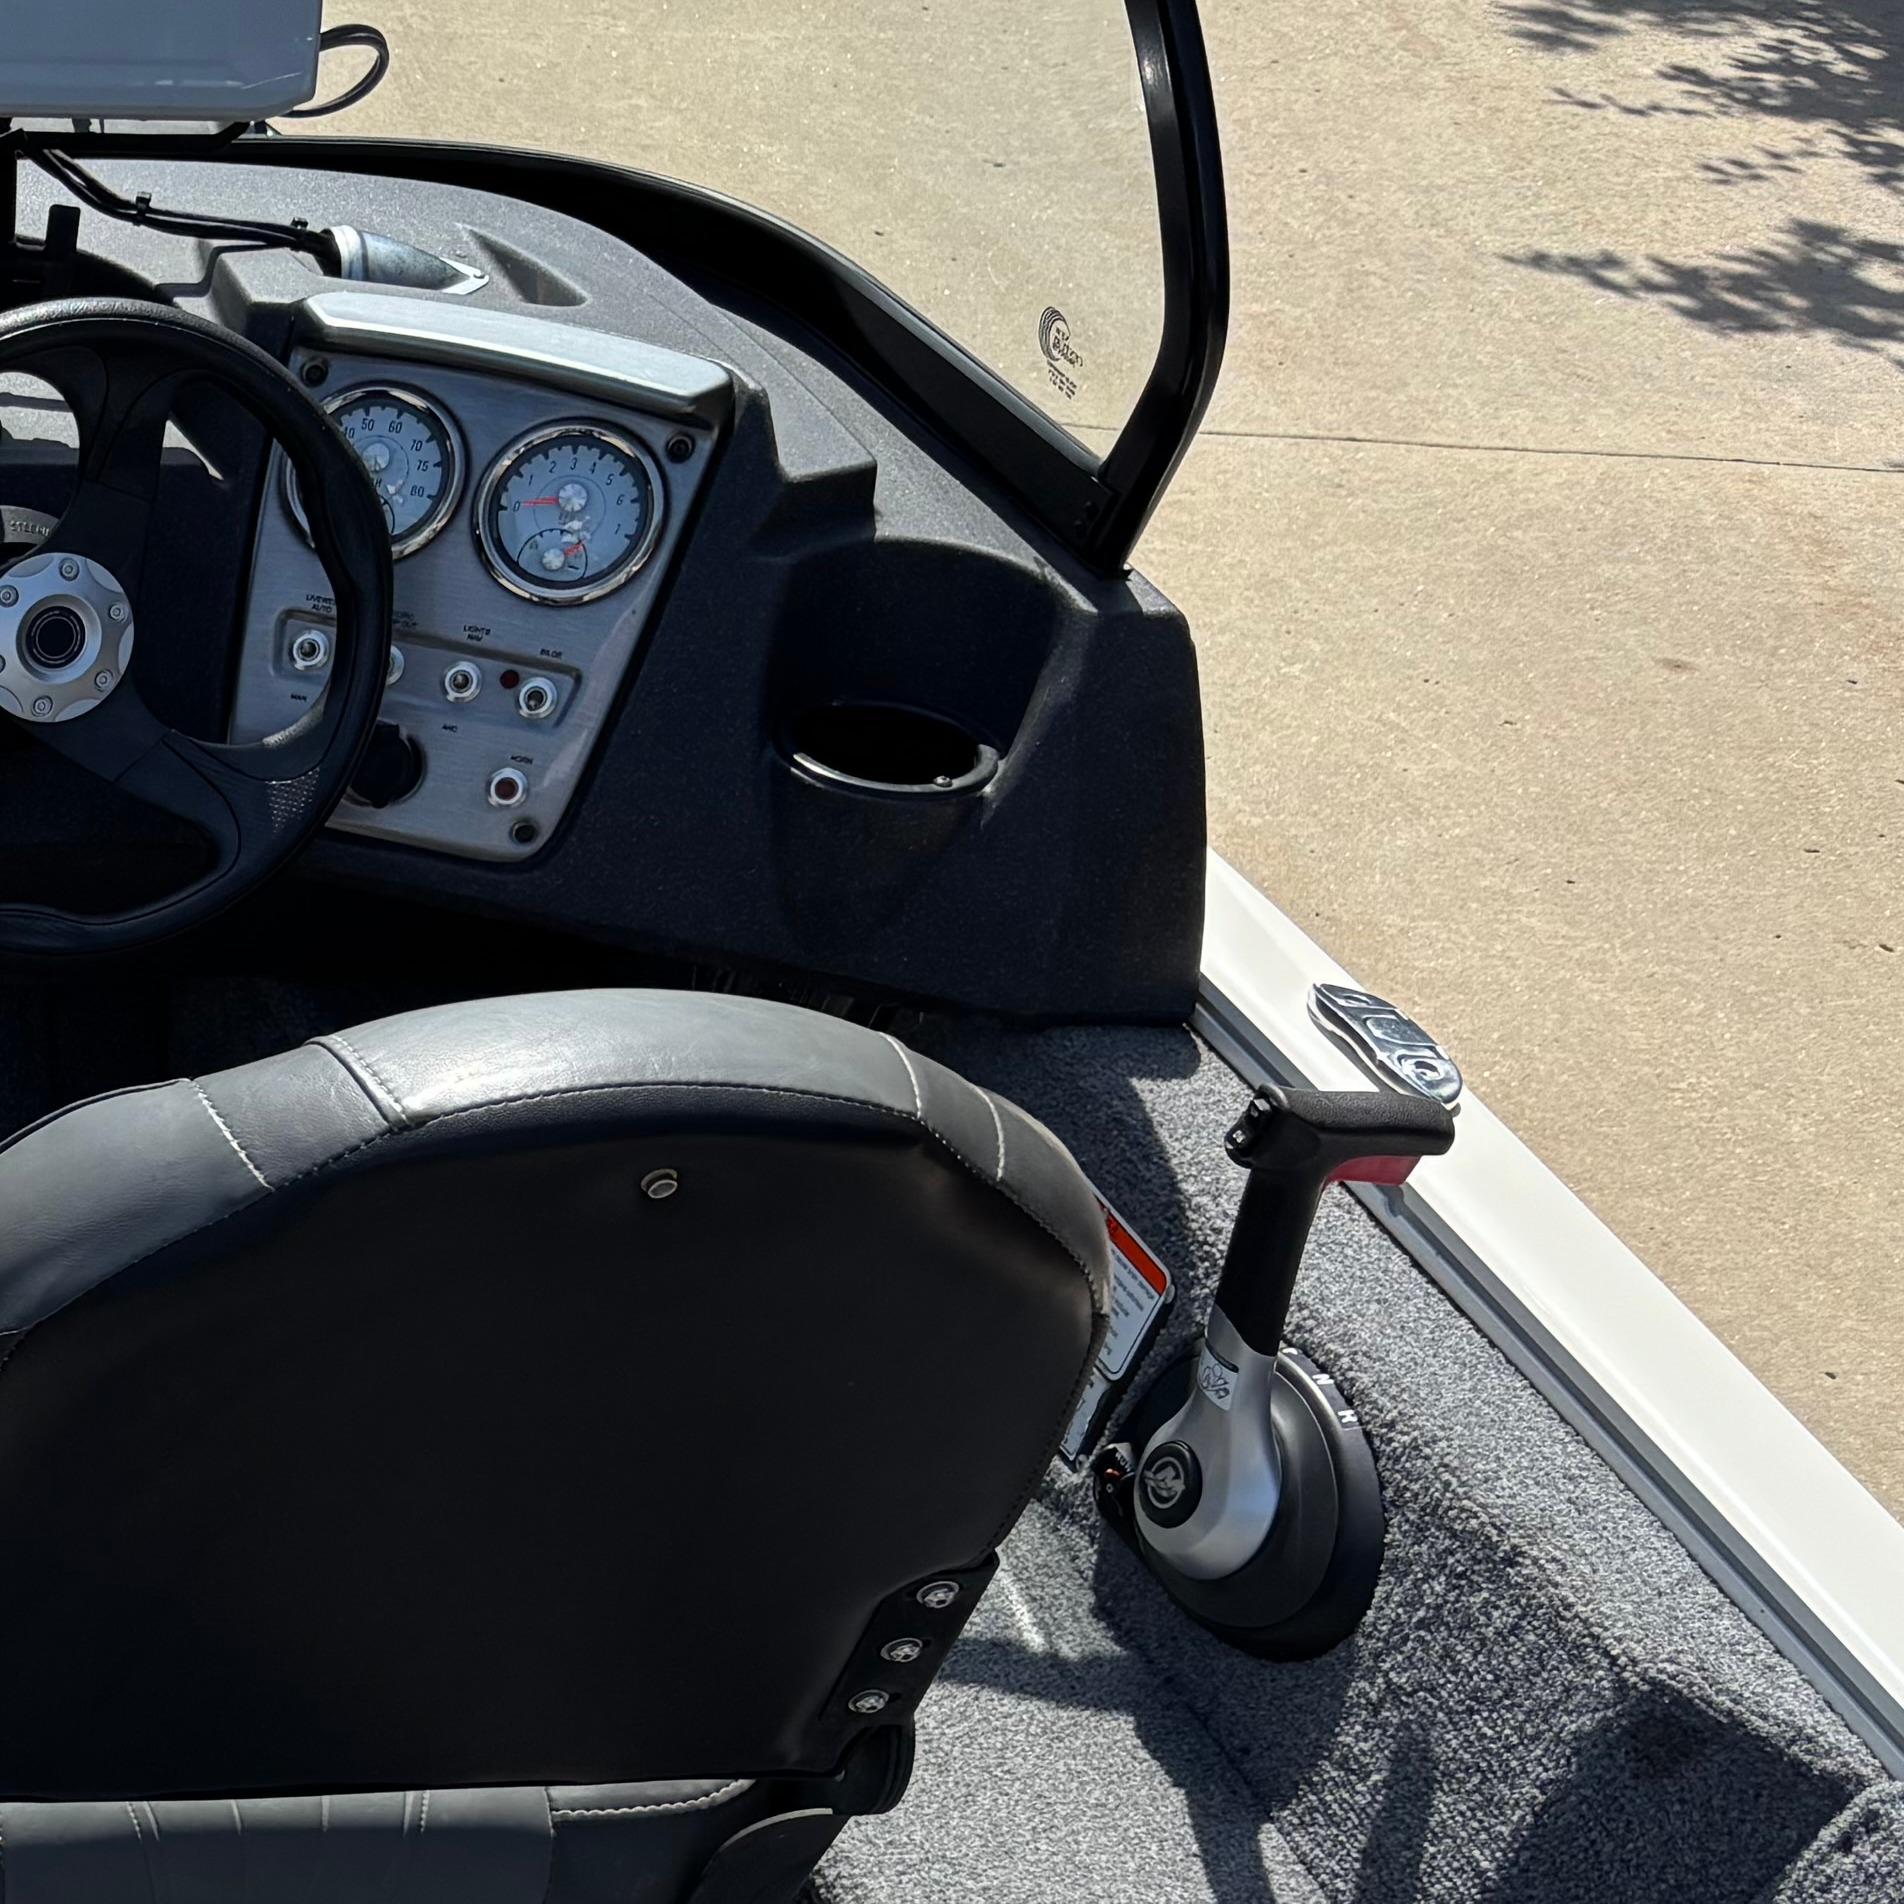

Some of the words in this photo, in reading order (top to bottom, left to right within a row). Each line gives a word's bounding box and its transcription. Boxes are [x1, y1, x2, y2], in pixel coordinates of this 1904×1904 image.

[361, 417, 374, 431] 50
[388, 420, 402, 434] 60
[411, 440, 423, 451] 70
[417, 460, 429, 472] 75
[549, 461, 557, 474] 2
[570, 457, 578, 470] 3
[528, 474, 533, 486] 1
[606, 473, 614, 486] 5
[410, 485, 424, 498] 80
[617, 494, 624, 506] 6
[512, 501, 521, 513] 0
[463, 625, 491, 636] LIGHTS
[1312, 1373, 1335, 1386] N
[1337, 1409, 1358, 1424] R
